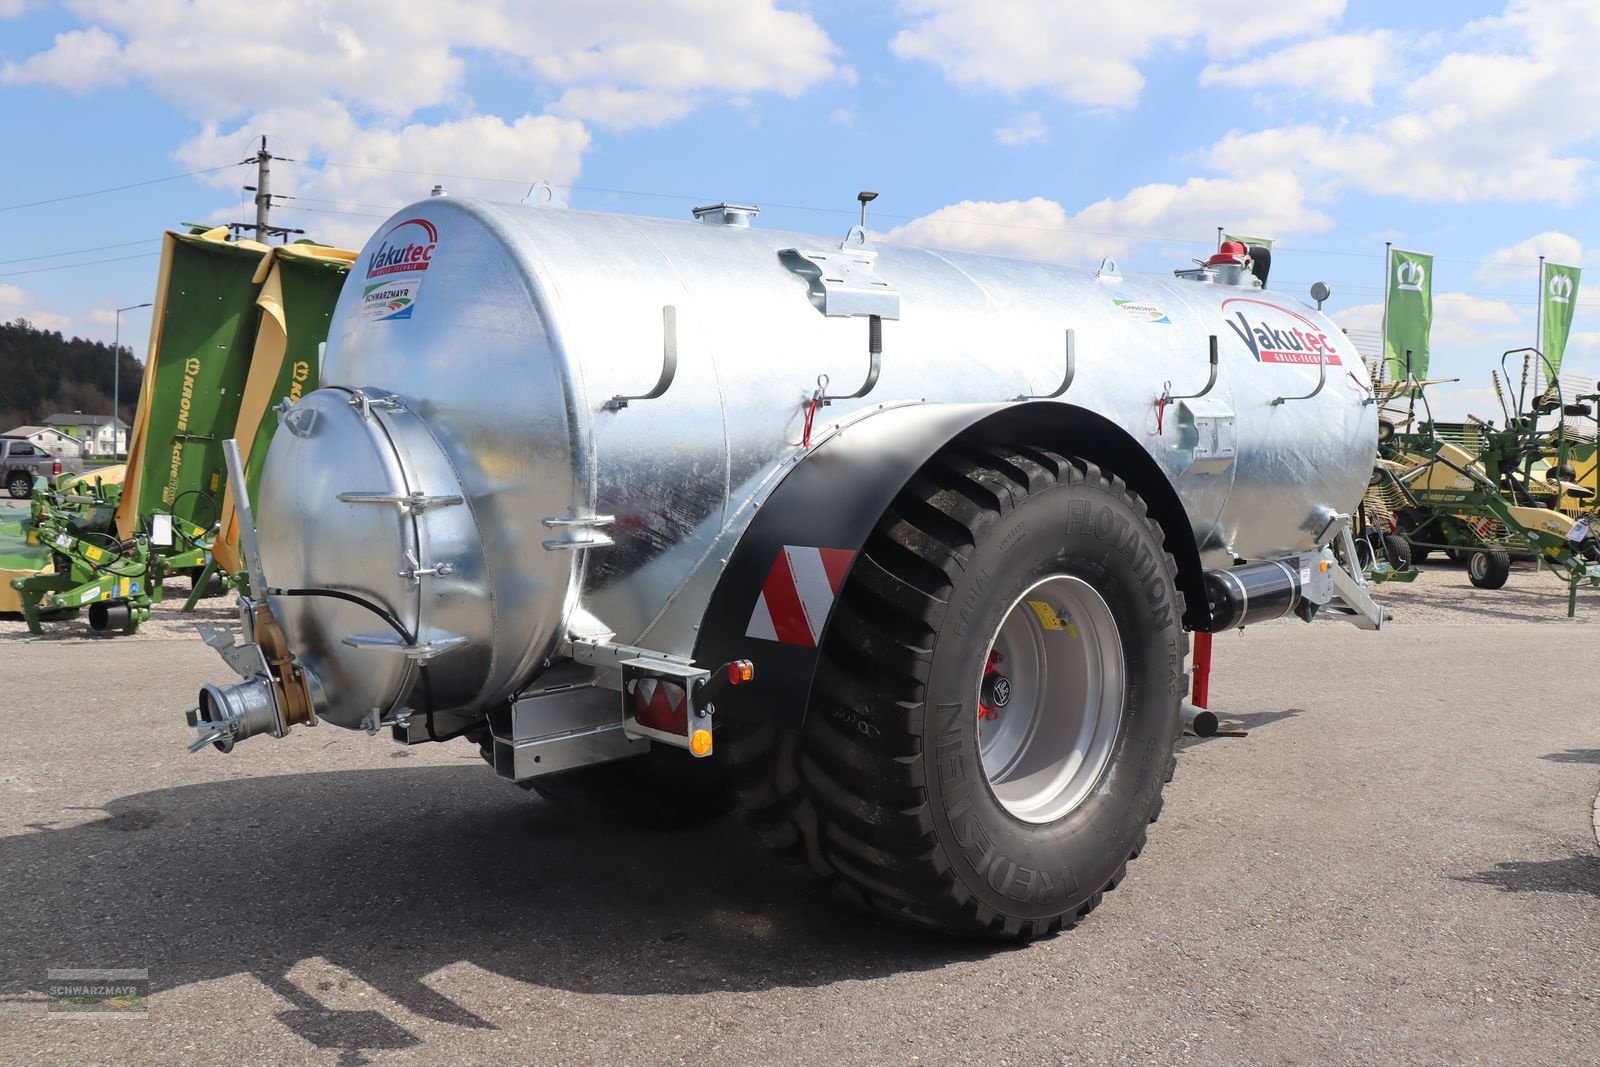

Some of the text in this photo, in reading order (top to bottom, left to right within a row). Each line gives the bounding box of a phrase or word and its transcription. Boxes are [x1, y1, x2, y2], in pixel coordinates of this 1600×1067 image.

[366, 241, 436, 280] Vakutec
[365, 288, 409, 302] SCHWARZMAYR
[1225, 311, 1337, 362] Vakutec
[177, 374, 195, 432] KRONE
[1064, 499, 1174, 634] FLOTATION
[1168, 639, 1177, 696] TRAC
[936, 702, 1080, 905] VREDESTEIN
